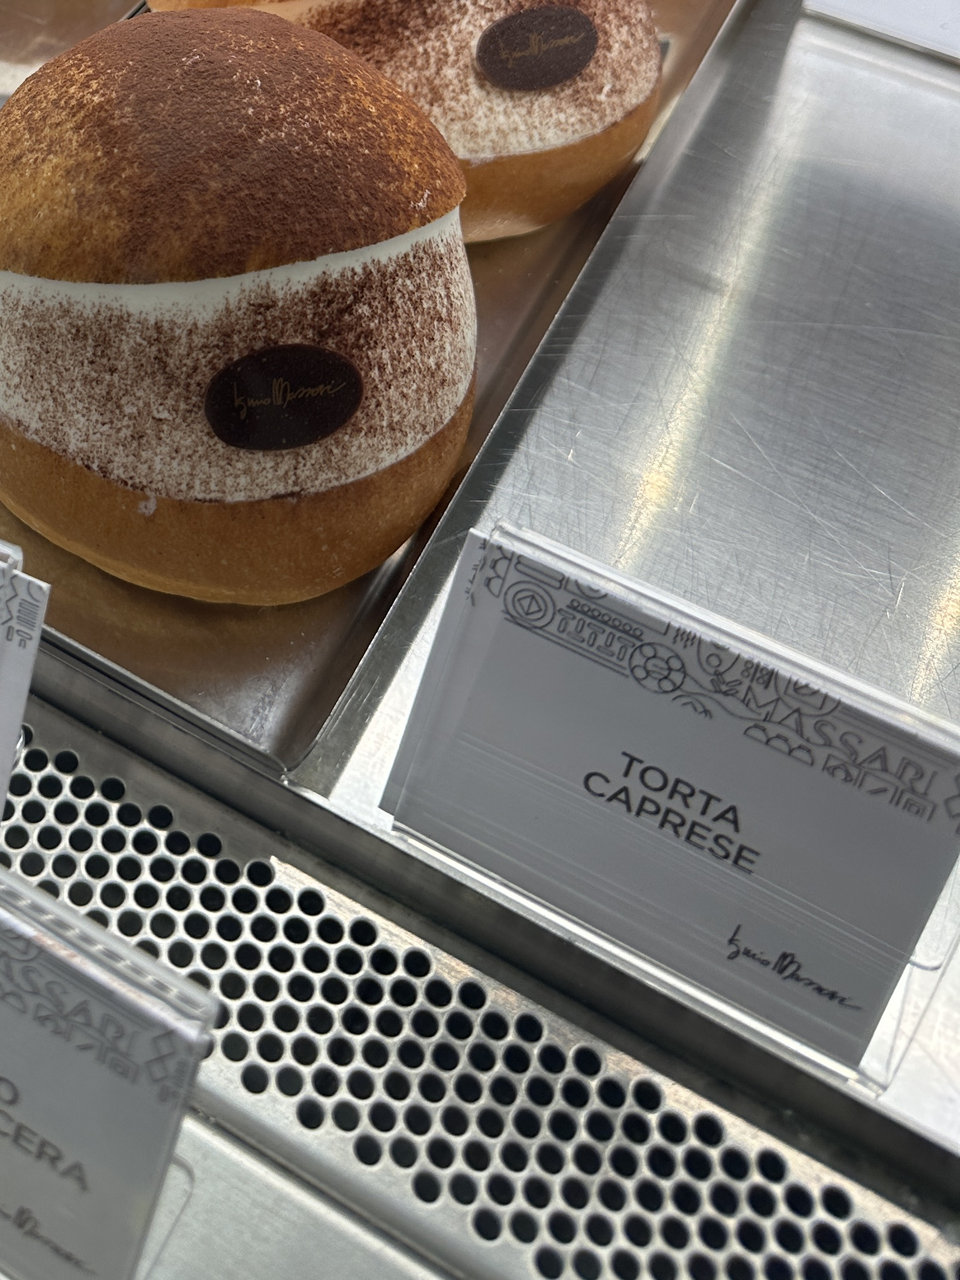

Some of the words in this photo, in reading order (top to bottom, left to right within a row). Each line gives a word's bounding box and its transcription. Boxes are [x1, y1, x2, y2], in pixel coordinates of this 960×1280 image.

[621, 750, 740, 833] TORTA
[742, 685, 938, 797] MASSARI
[583, 771, 761, 875] CAPRESE
